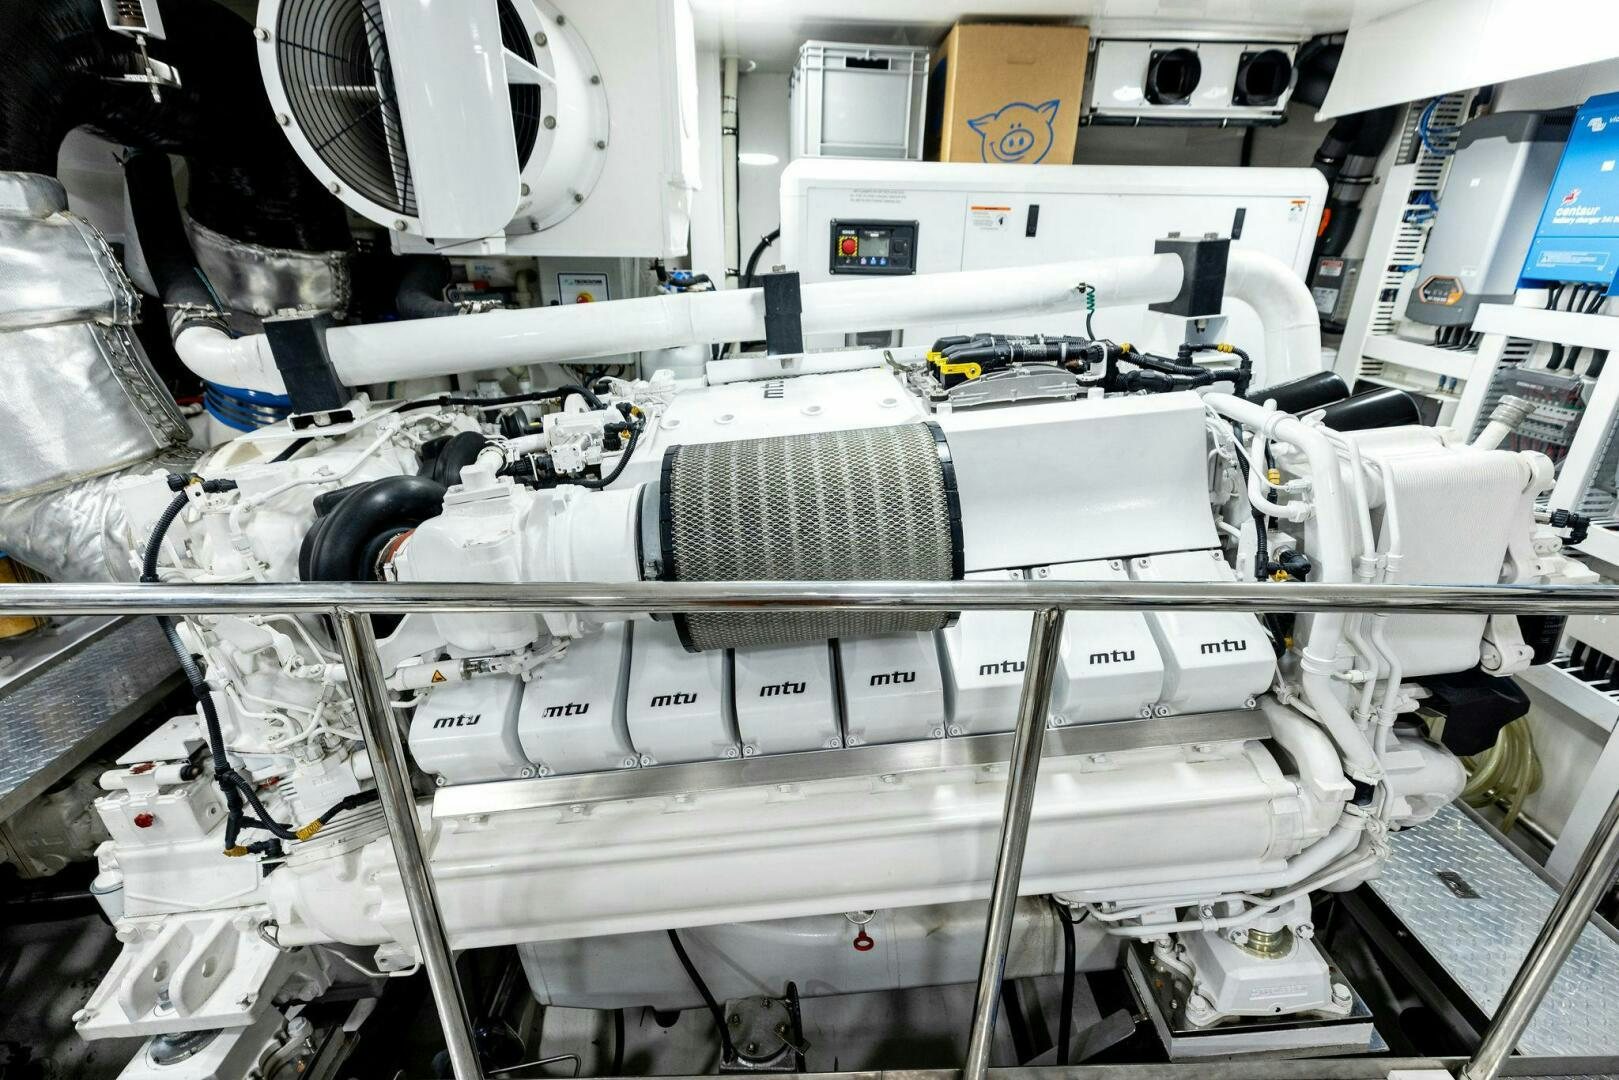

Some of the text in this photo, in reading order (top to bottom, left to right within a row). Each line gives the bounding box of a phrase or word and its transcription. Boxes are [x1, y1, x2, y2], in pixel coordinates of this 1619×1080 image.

[1555, 206, 1600, 216] centaur
[1201, 639, 1247, 654] mtu
[1089, 650, 1135, 665] mtu
[979, 660, 1025, 676] mtu
[870, 671, 916, 687] mtu
[760, 681, 807, 697] mtu
[650, 692, 698, 708] mtu
[543, 702, 590, 718] mtu
[433, 714, 481, 729] mtu
